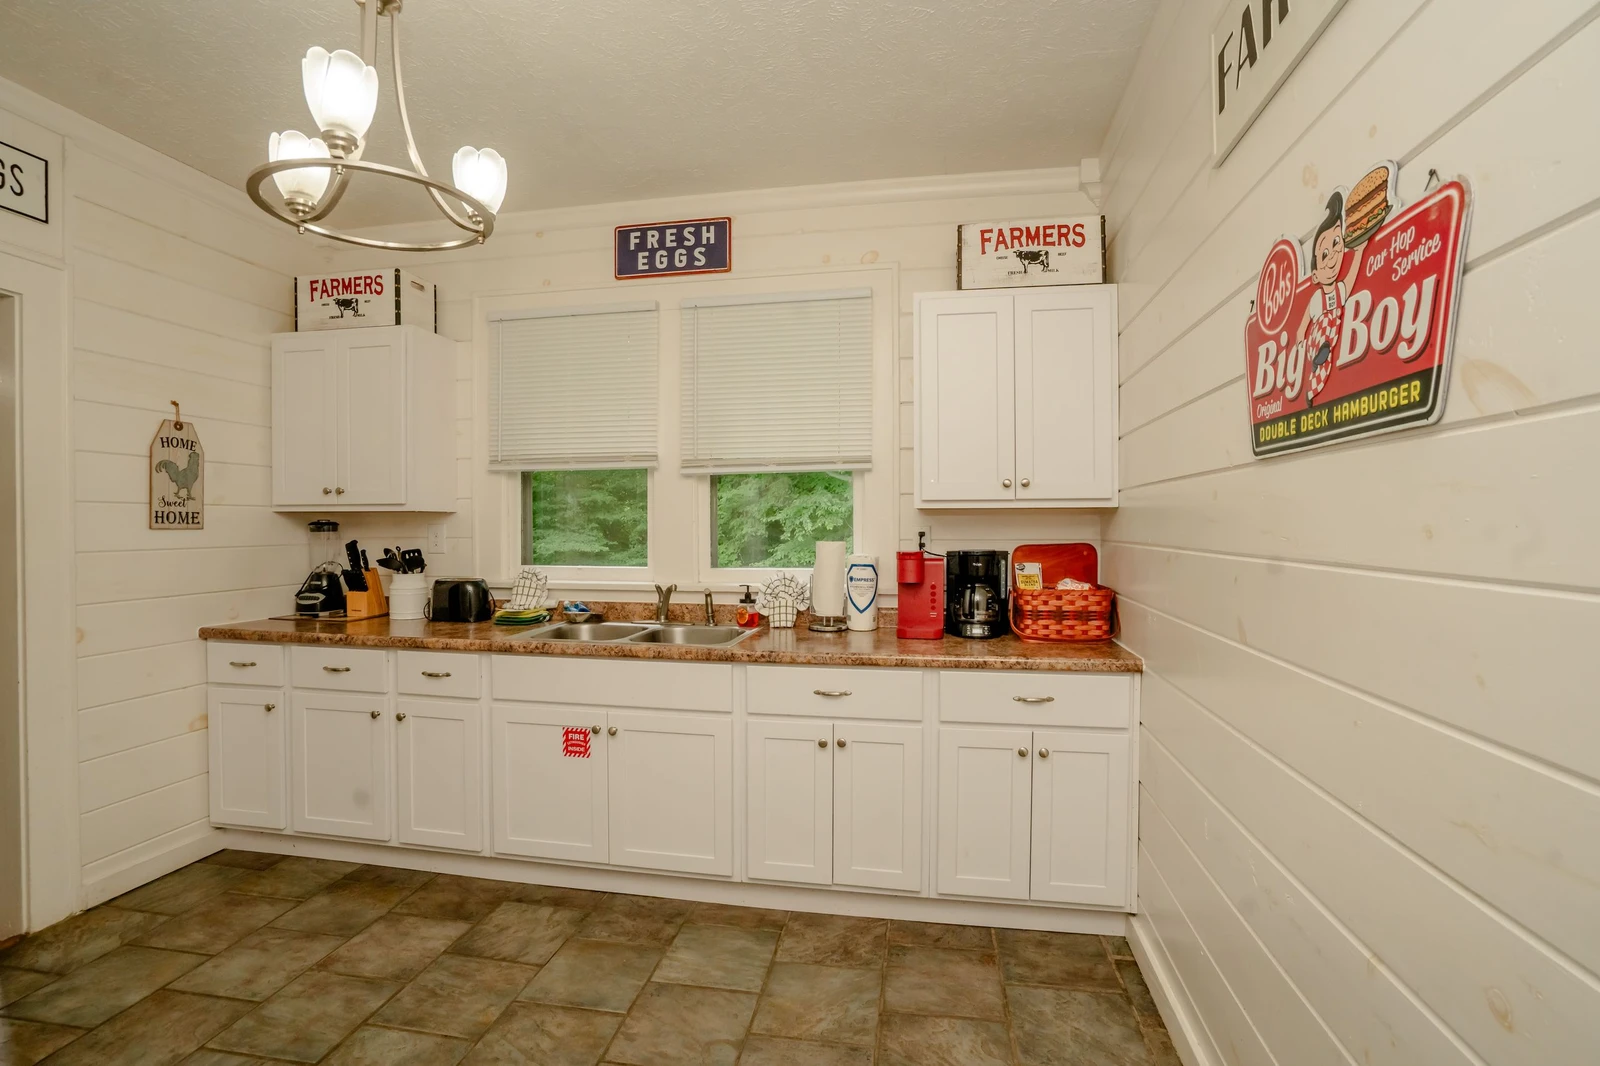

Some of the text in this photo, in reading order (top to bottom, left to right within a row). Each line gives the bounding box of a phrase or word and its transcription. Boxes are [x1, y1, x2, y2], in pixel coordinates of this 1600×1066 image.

[629, 226, 715, 250] FRESH
[980, 223, 1086, 255] FARMERS
[1366, 226, 1416, 277] Car Hop
[637, 247, 706, 270] EGGS
[1392, 233, 1441, 281] Service
[309, 274, 384, 303] FARMERS
[1263, 261, 1291, 326] Bob's
[1253, 273, 1438, 398] Big Boy
[1256, 396, 1283, 418] Original
[1259, 380, 1421, 443] DOUBLE DECK HAMBURGER
[159, 436, 198, 452] HOME
[158, 495, 186, 508] Sweet
[154, 510, 201, 525] HOME
